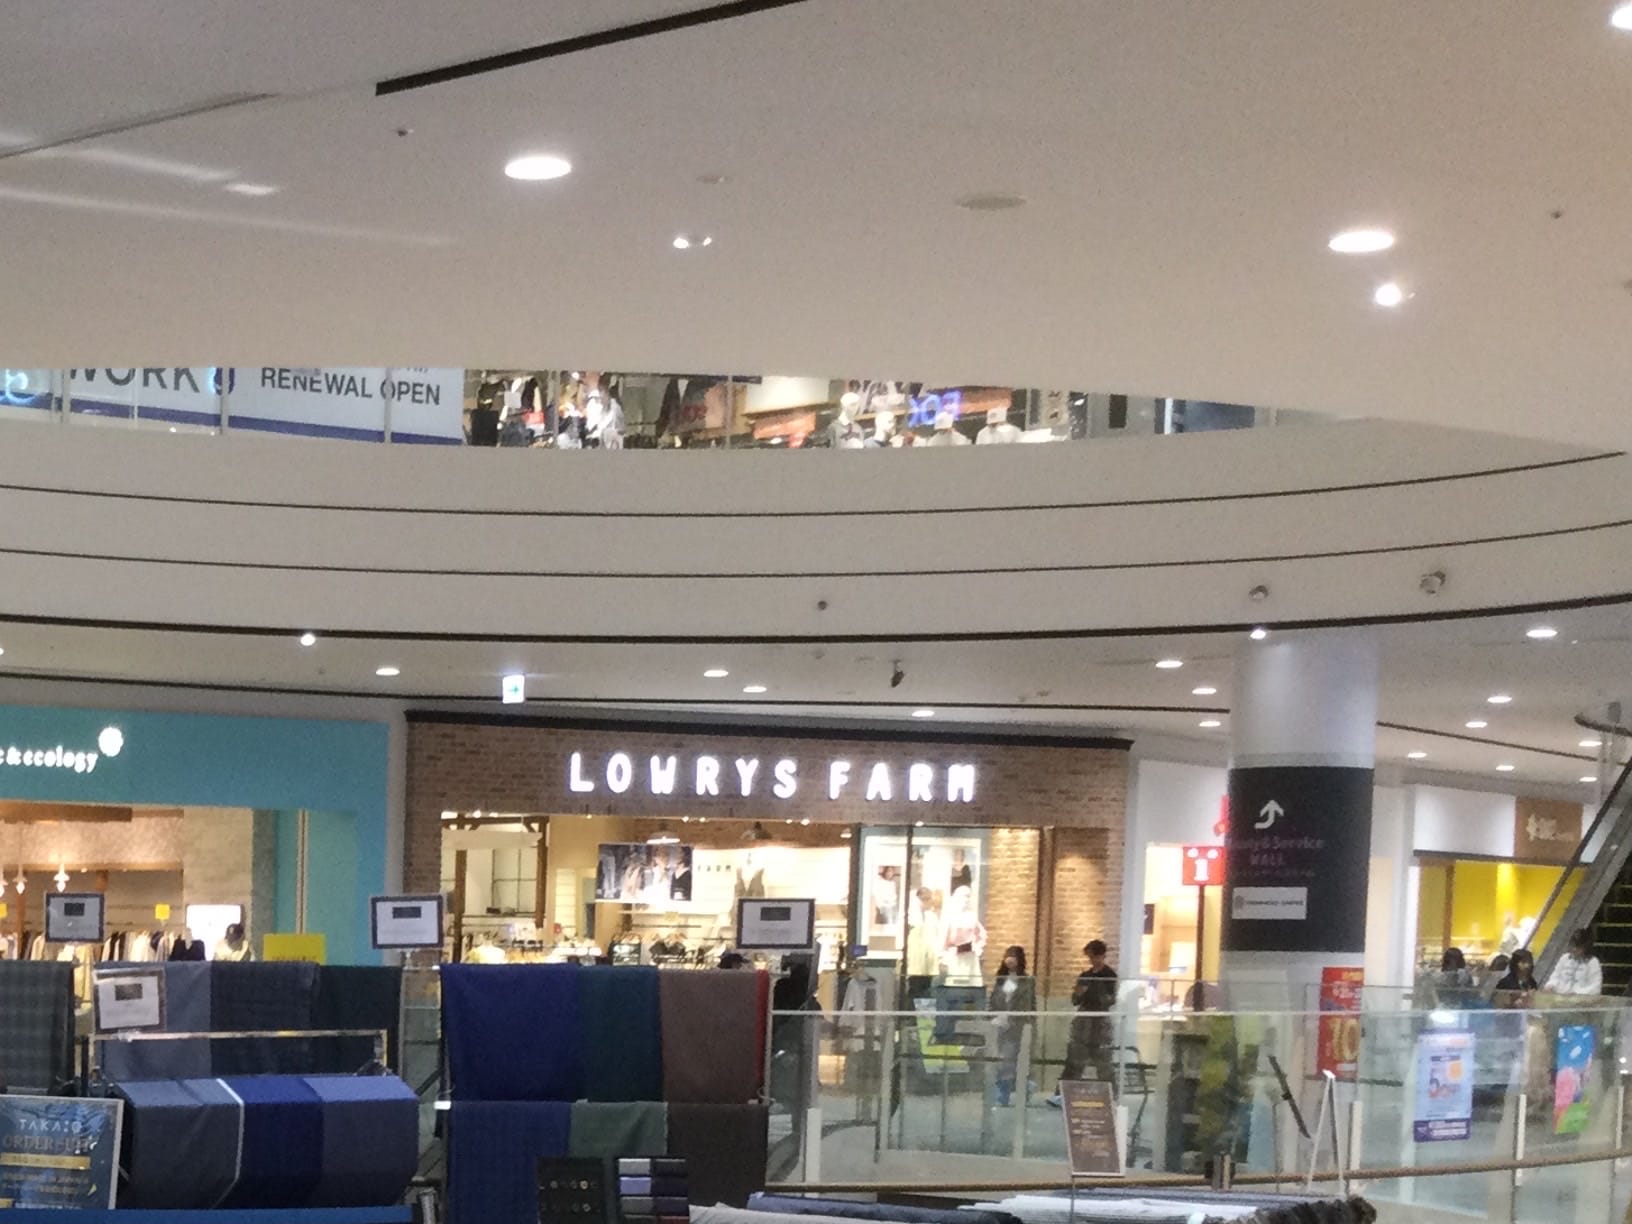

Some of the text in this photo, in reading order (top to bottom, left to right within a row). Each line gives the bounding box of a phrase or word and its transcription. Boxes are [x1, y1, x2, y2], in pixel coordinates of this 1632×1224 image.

[261, 367, 373, 399] RENEWAL
[380, 377, 440, 406] OPEN
[569, 752, 976, 802] LOWRYS FARM
